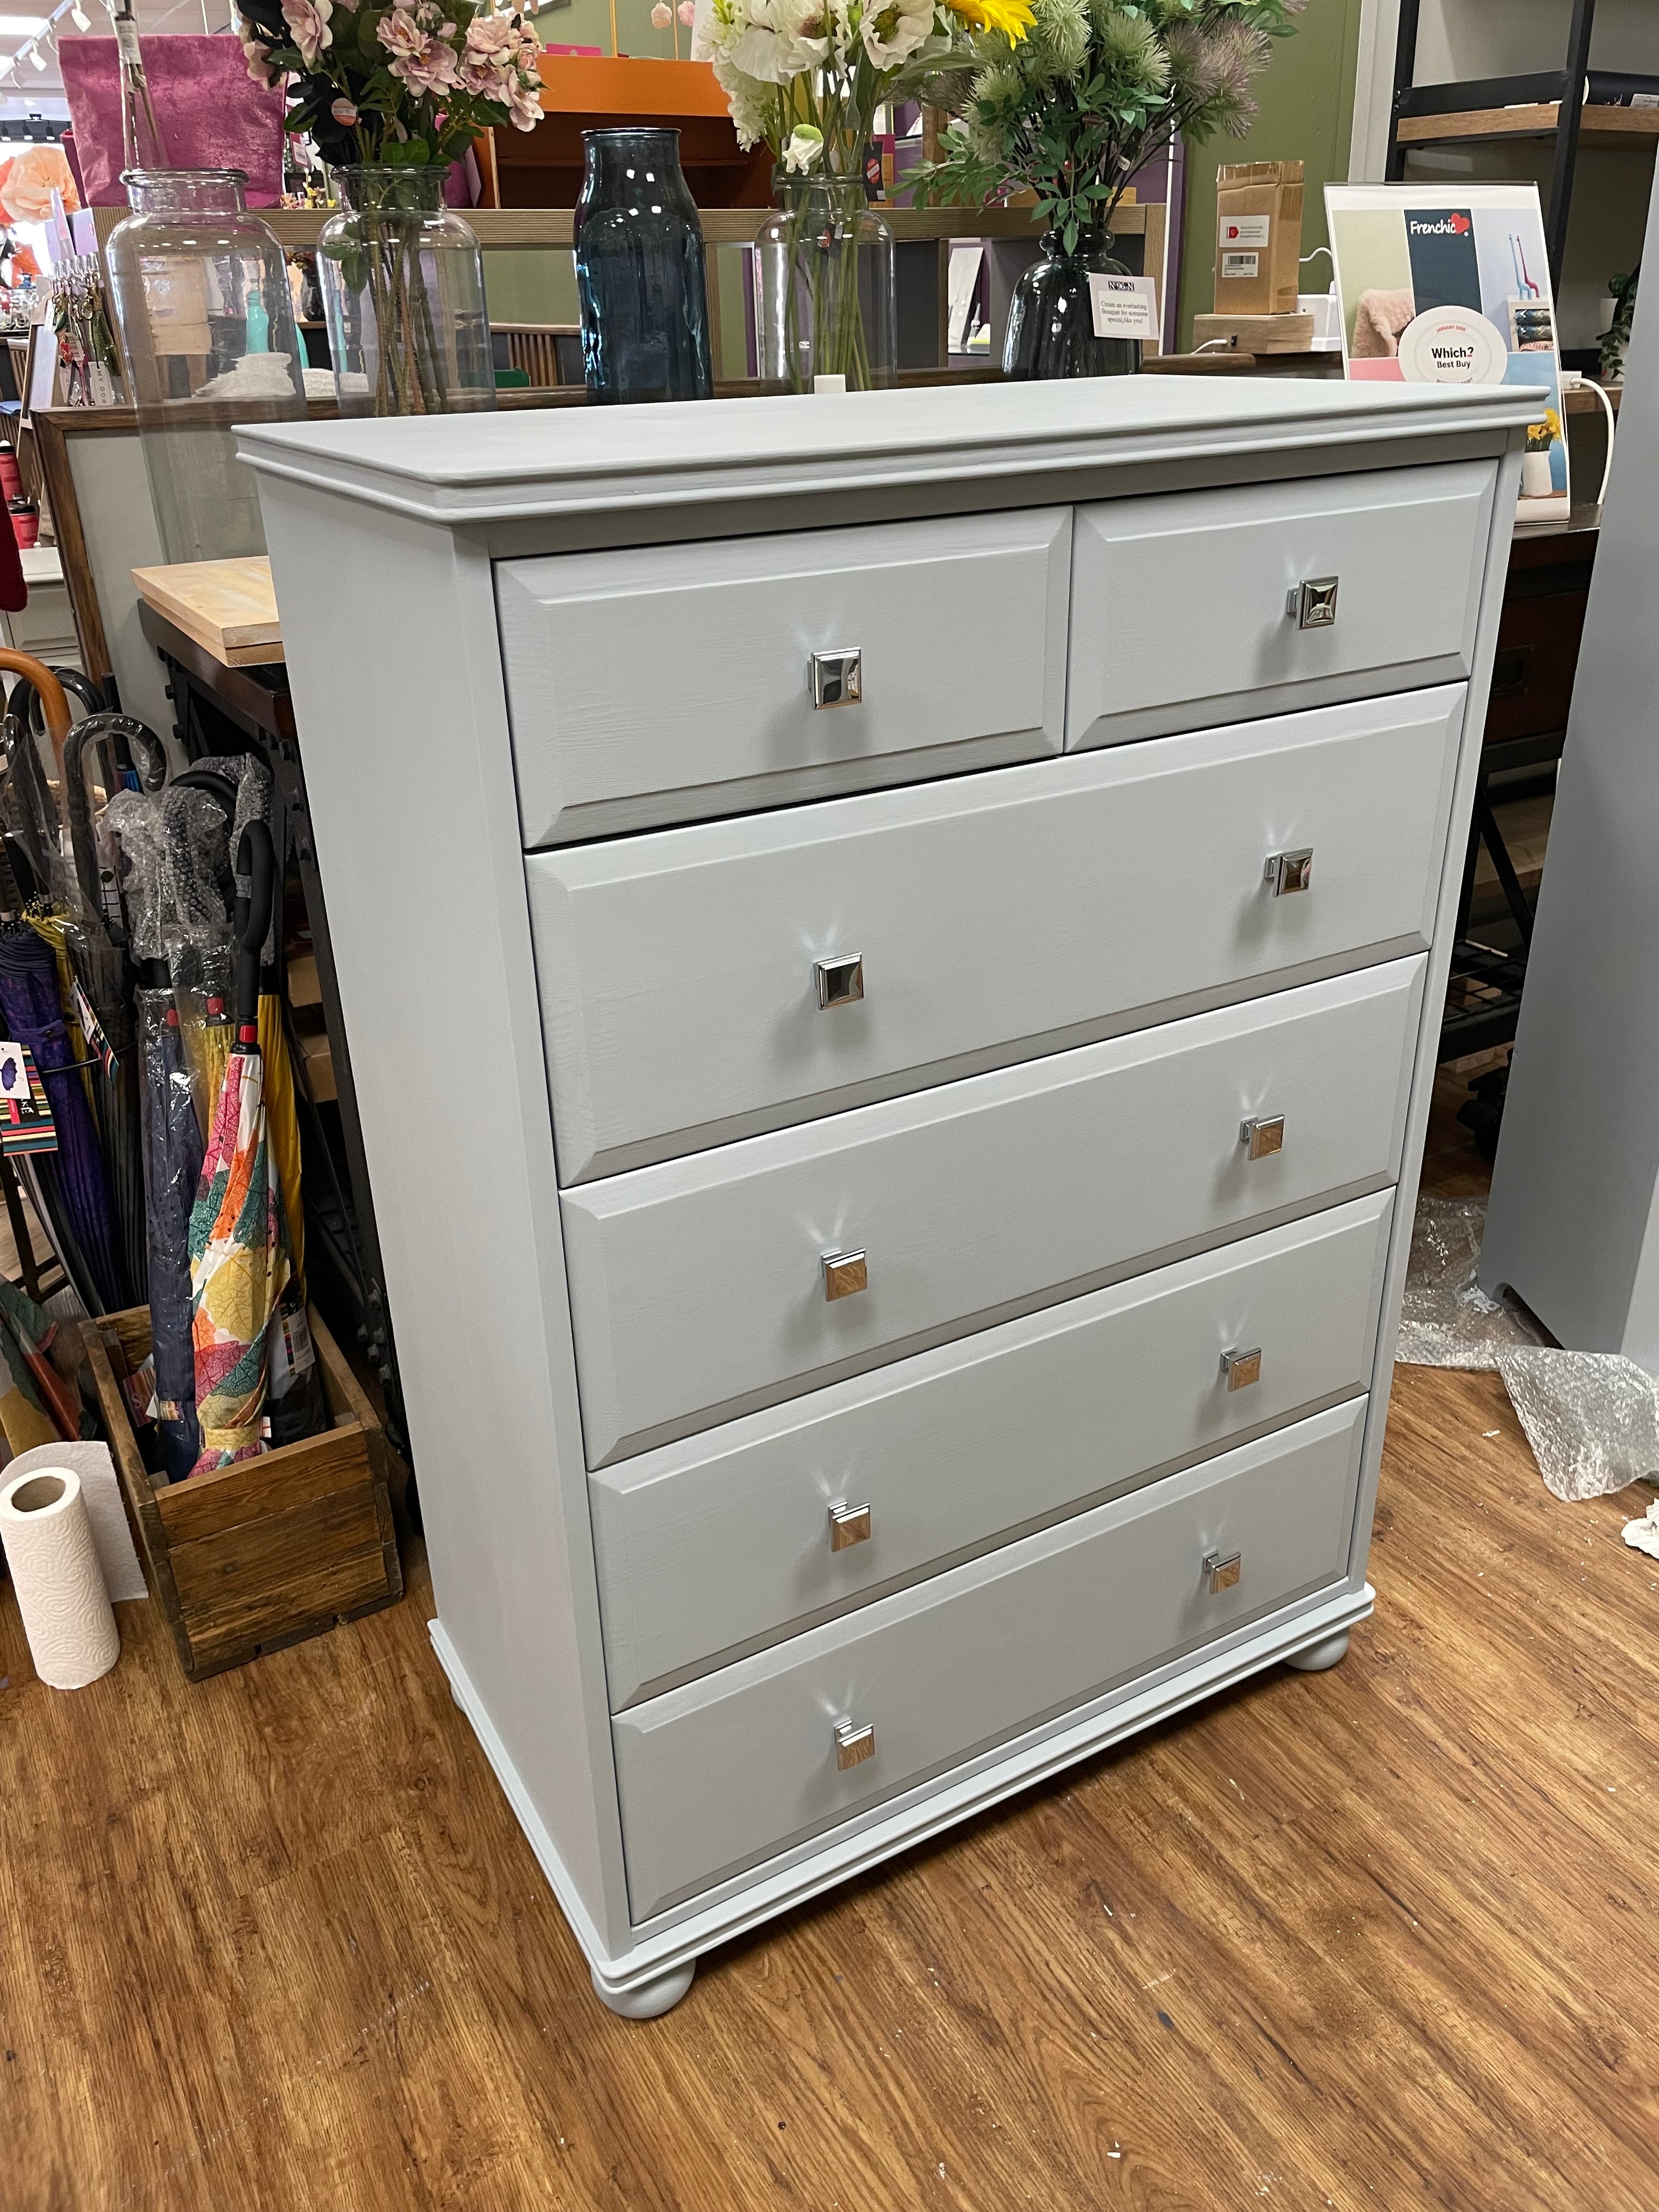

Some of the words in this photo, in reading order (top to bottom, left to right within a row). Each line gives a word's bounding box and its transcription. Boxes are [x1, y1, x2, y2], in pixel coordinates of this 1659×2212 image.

[1410, 219, 1456, 235] Frenchic
[1123, 302, 1147, 311] everlasting
[1102, 308, 1120, 316] Bouquet
[1431, 346, 1474, 359] Which?
[1456, 360, 1471, 369] Buy
[97, 370, 103, 382] MY
